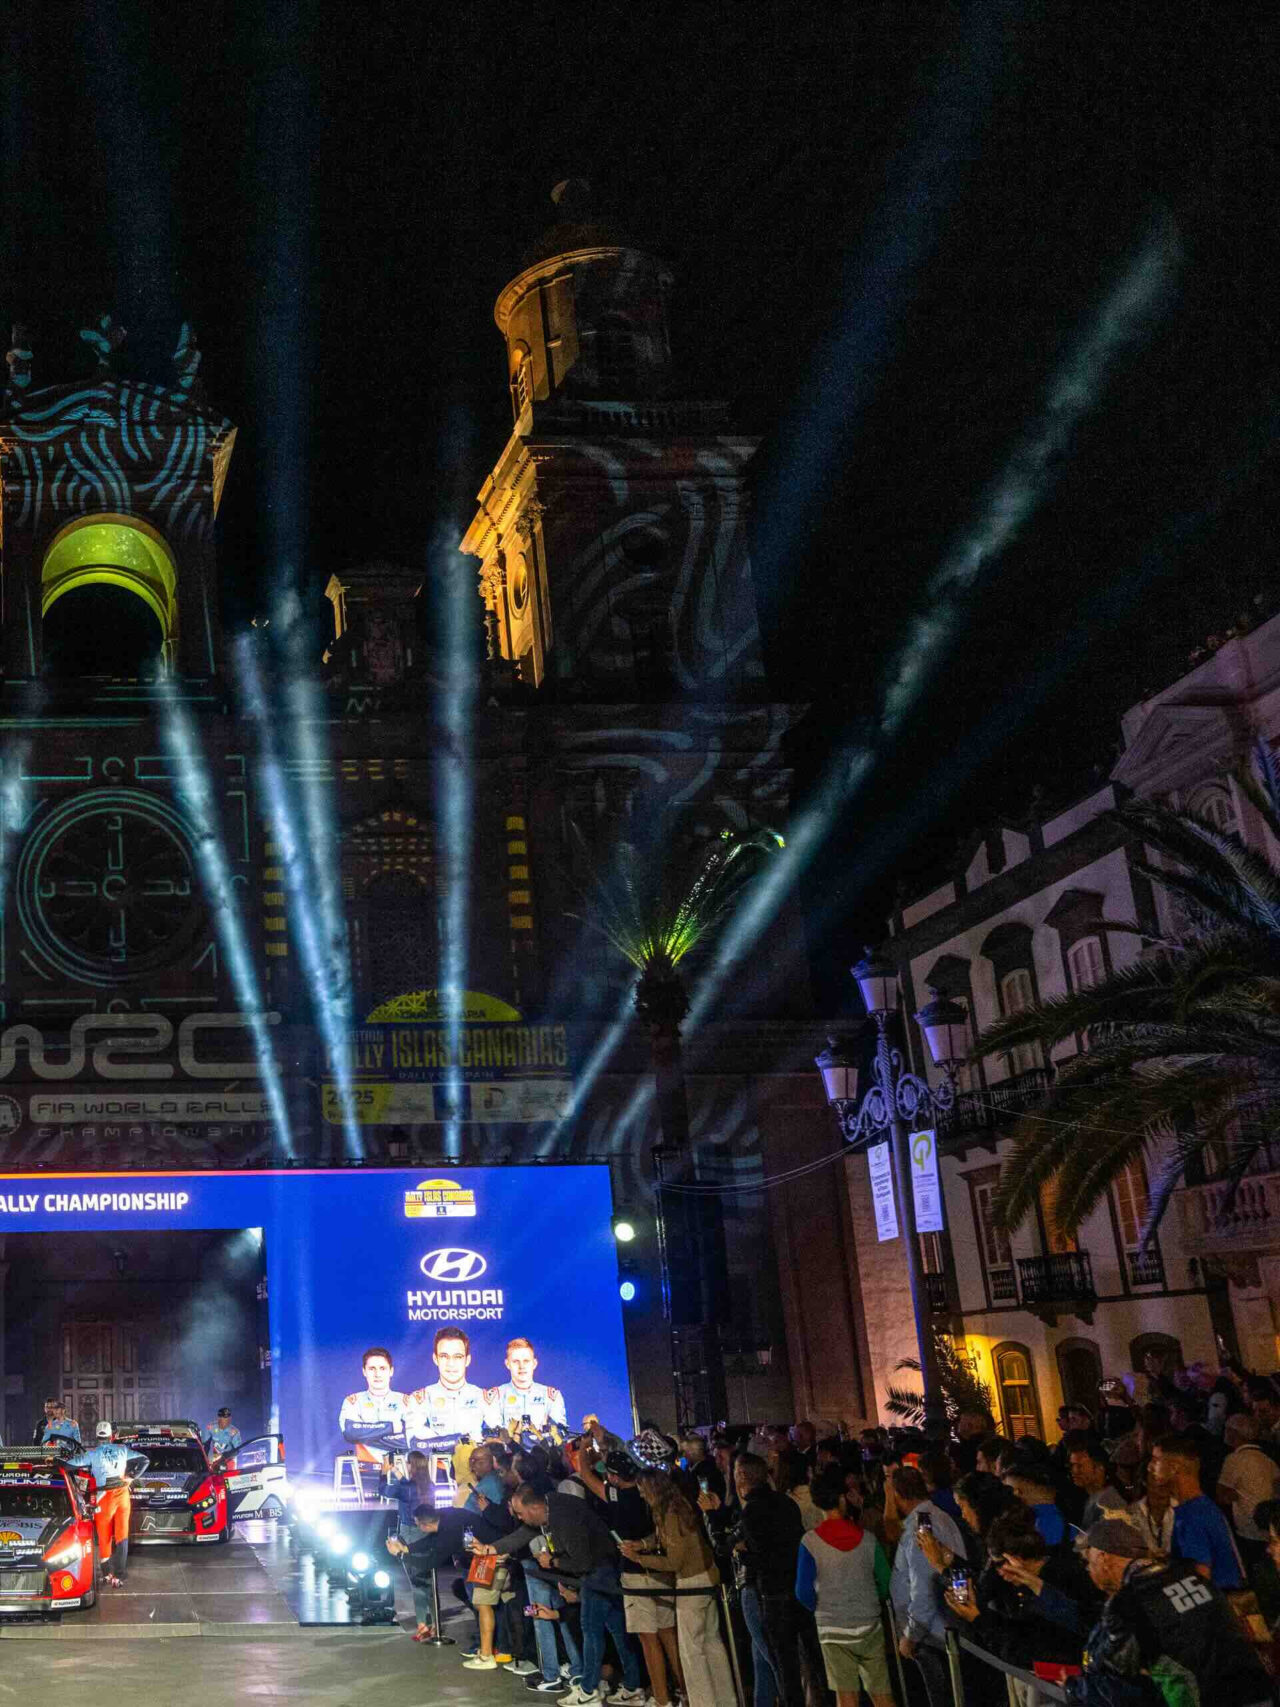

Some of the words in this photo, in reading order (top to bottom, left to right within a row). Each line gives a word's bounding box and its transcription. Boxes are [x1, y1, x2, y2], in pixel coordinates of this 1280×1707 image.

[391, 1029, 450, 1068] ISLAS
[458, 1023, 567, 1067] CANARIAS
[327, 1090, 374, 1105] 225
[37, 1102, 75, 1115] FIA
[83, 1101, 177, 1115] WORLD
[43, 1191, 190, 1212] CHAMPIONSHIP
[406, 1289, 504, 1307] HYUNDAI
[407, 1307, 504, 1321] MOTORSPORT
[1162, 1575, 1214, 1614] 25
